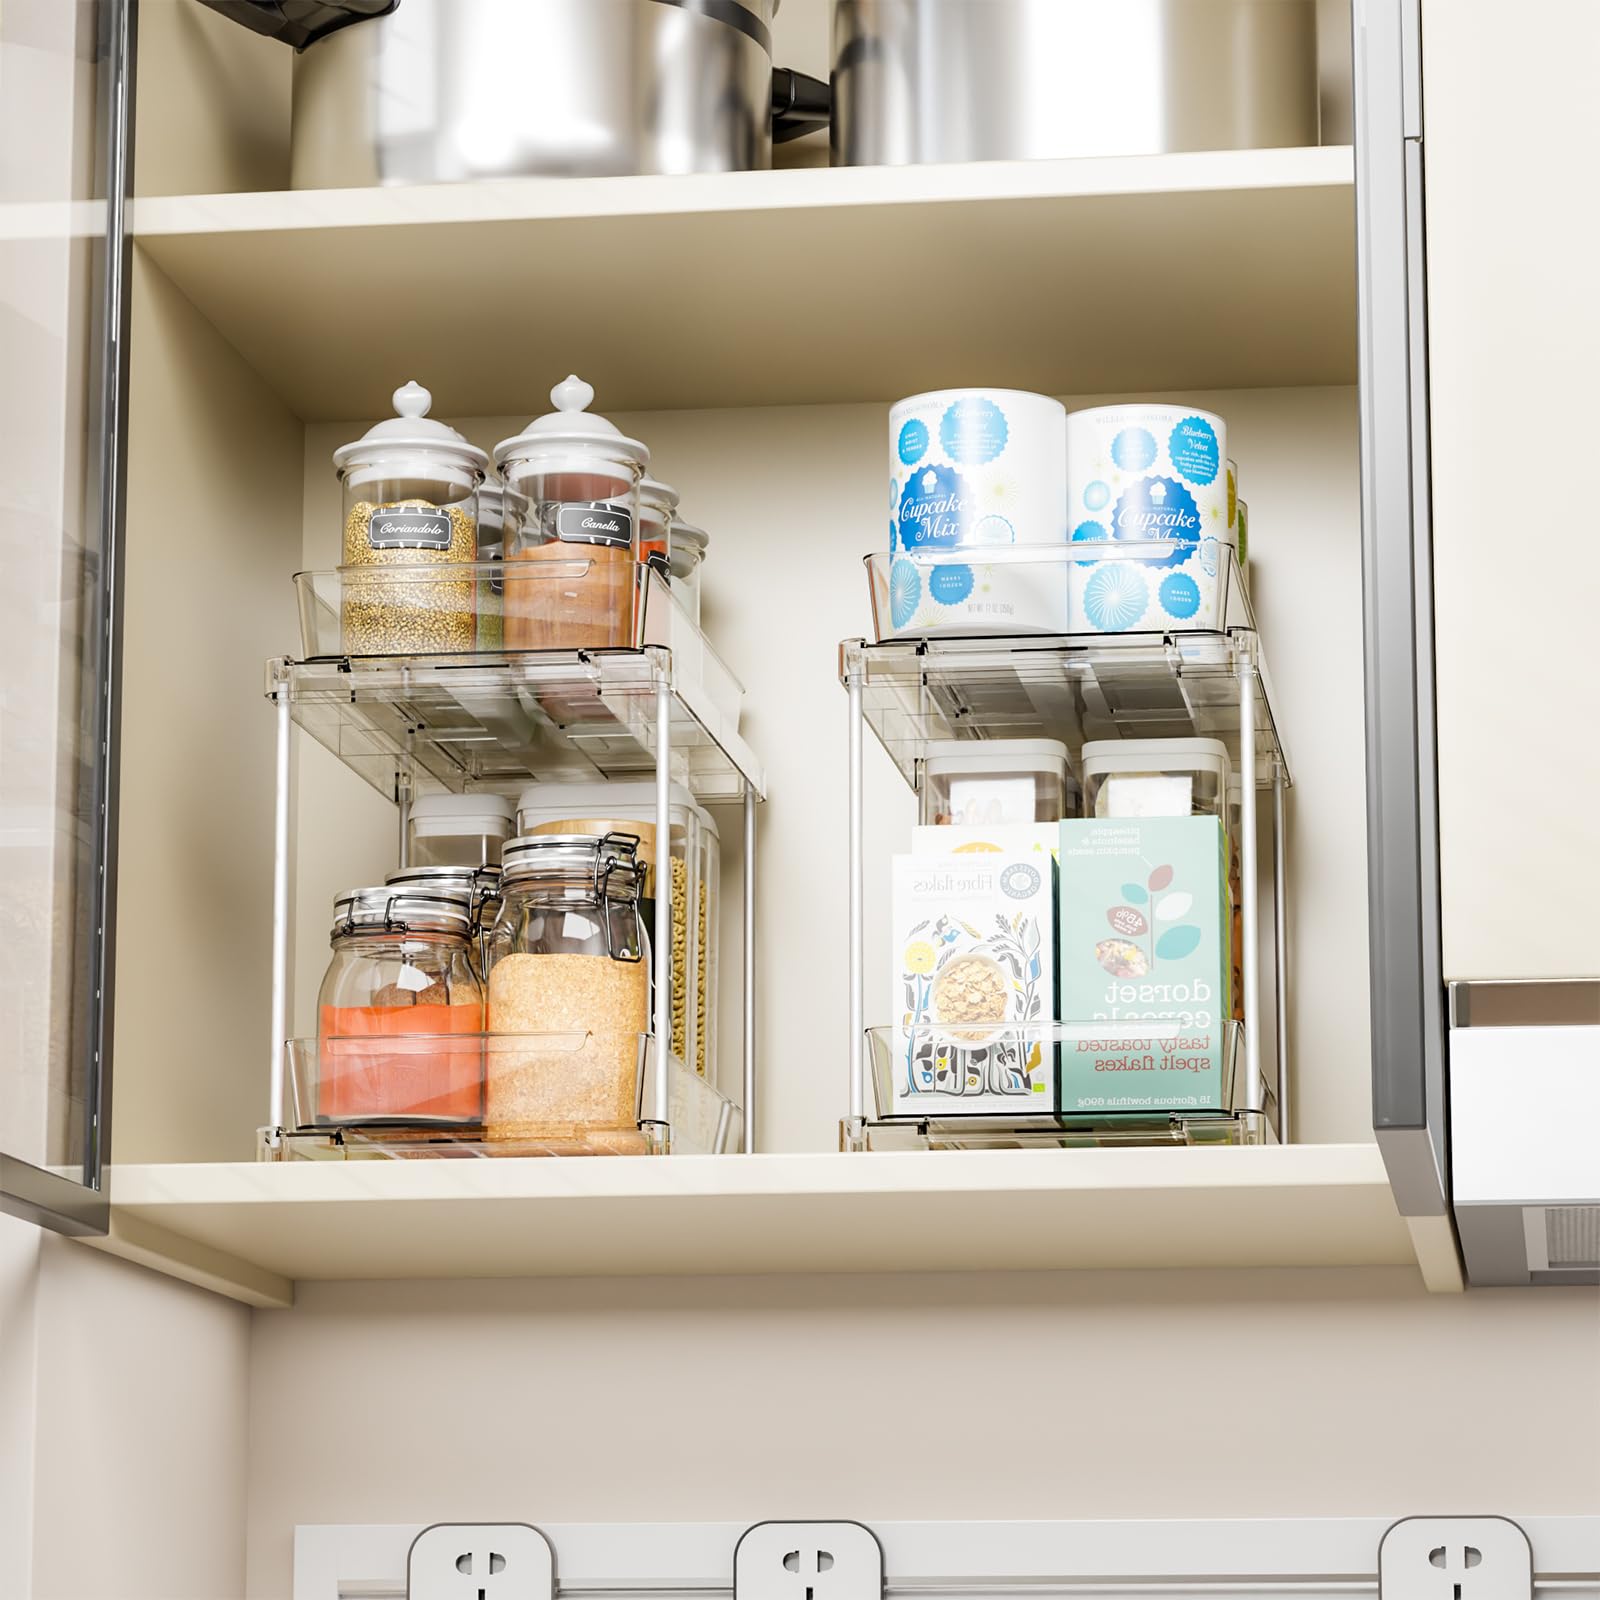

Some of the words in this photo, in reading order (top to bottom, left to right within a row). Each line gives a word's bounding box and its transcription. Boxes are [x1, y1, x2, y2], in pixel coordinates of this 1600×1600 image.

[1181, 425, 1212, 442] Blueberry
[1187, 438, 1208, 451] Velvet
[901, 493, 969, 523] Cupcake
[581, 517, 621, 532] Canella
[1117, 507, 1196, 532] Cupcake
[380, 522, 445, 535] Coriandolo
[915, 515, 960, 542] Mix
